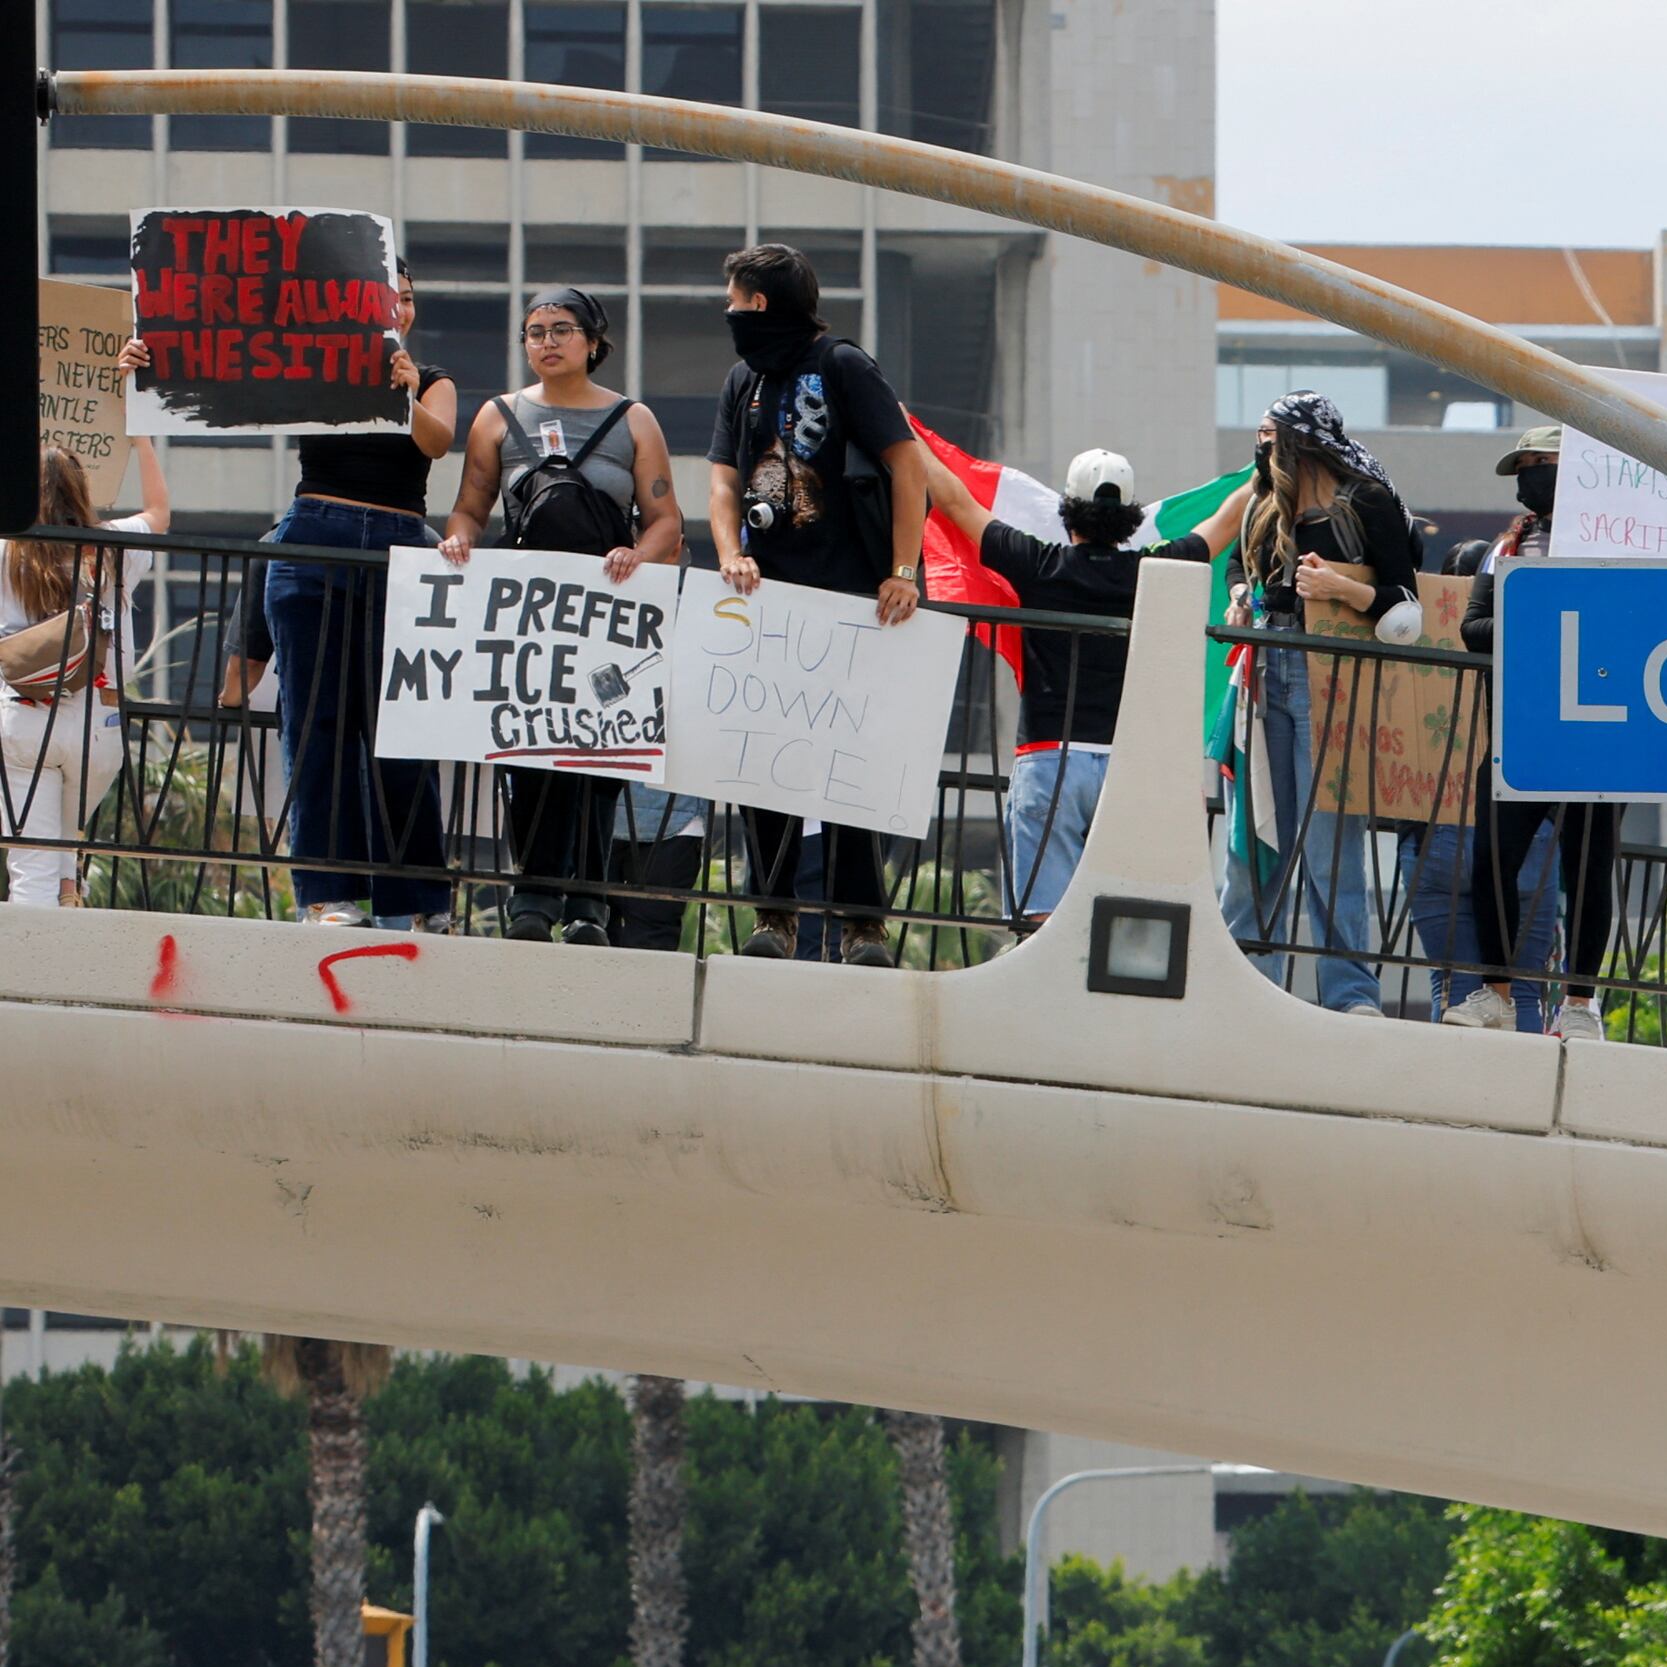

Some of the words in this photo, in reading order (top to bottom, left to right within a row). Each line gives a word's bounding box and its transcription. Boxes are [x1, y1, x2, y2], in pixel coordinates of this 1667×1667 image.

[162, 214, 309, 275] THEY
[136, 267, 265, 326] WERE
[56, 361, 123, 399] NEVER
[141, 329, 244, 381] THE
[247, 331, 385, 387] SITH
[414, 574, 465, 629] I
[483, 576, 665, 651] PREFER
[700, 596, 882, 681] SHUT
[384, 648, 463, 701] MY
[472, 638, 579, 705] ICE
[706, 662, 869, 735] DOWN
